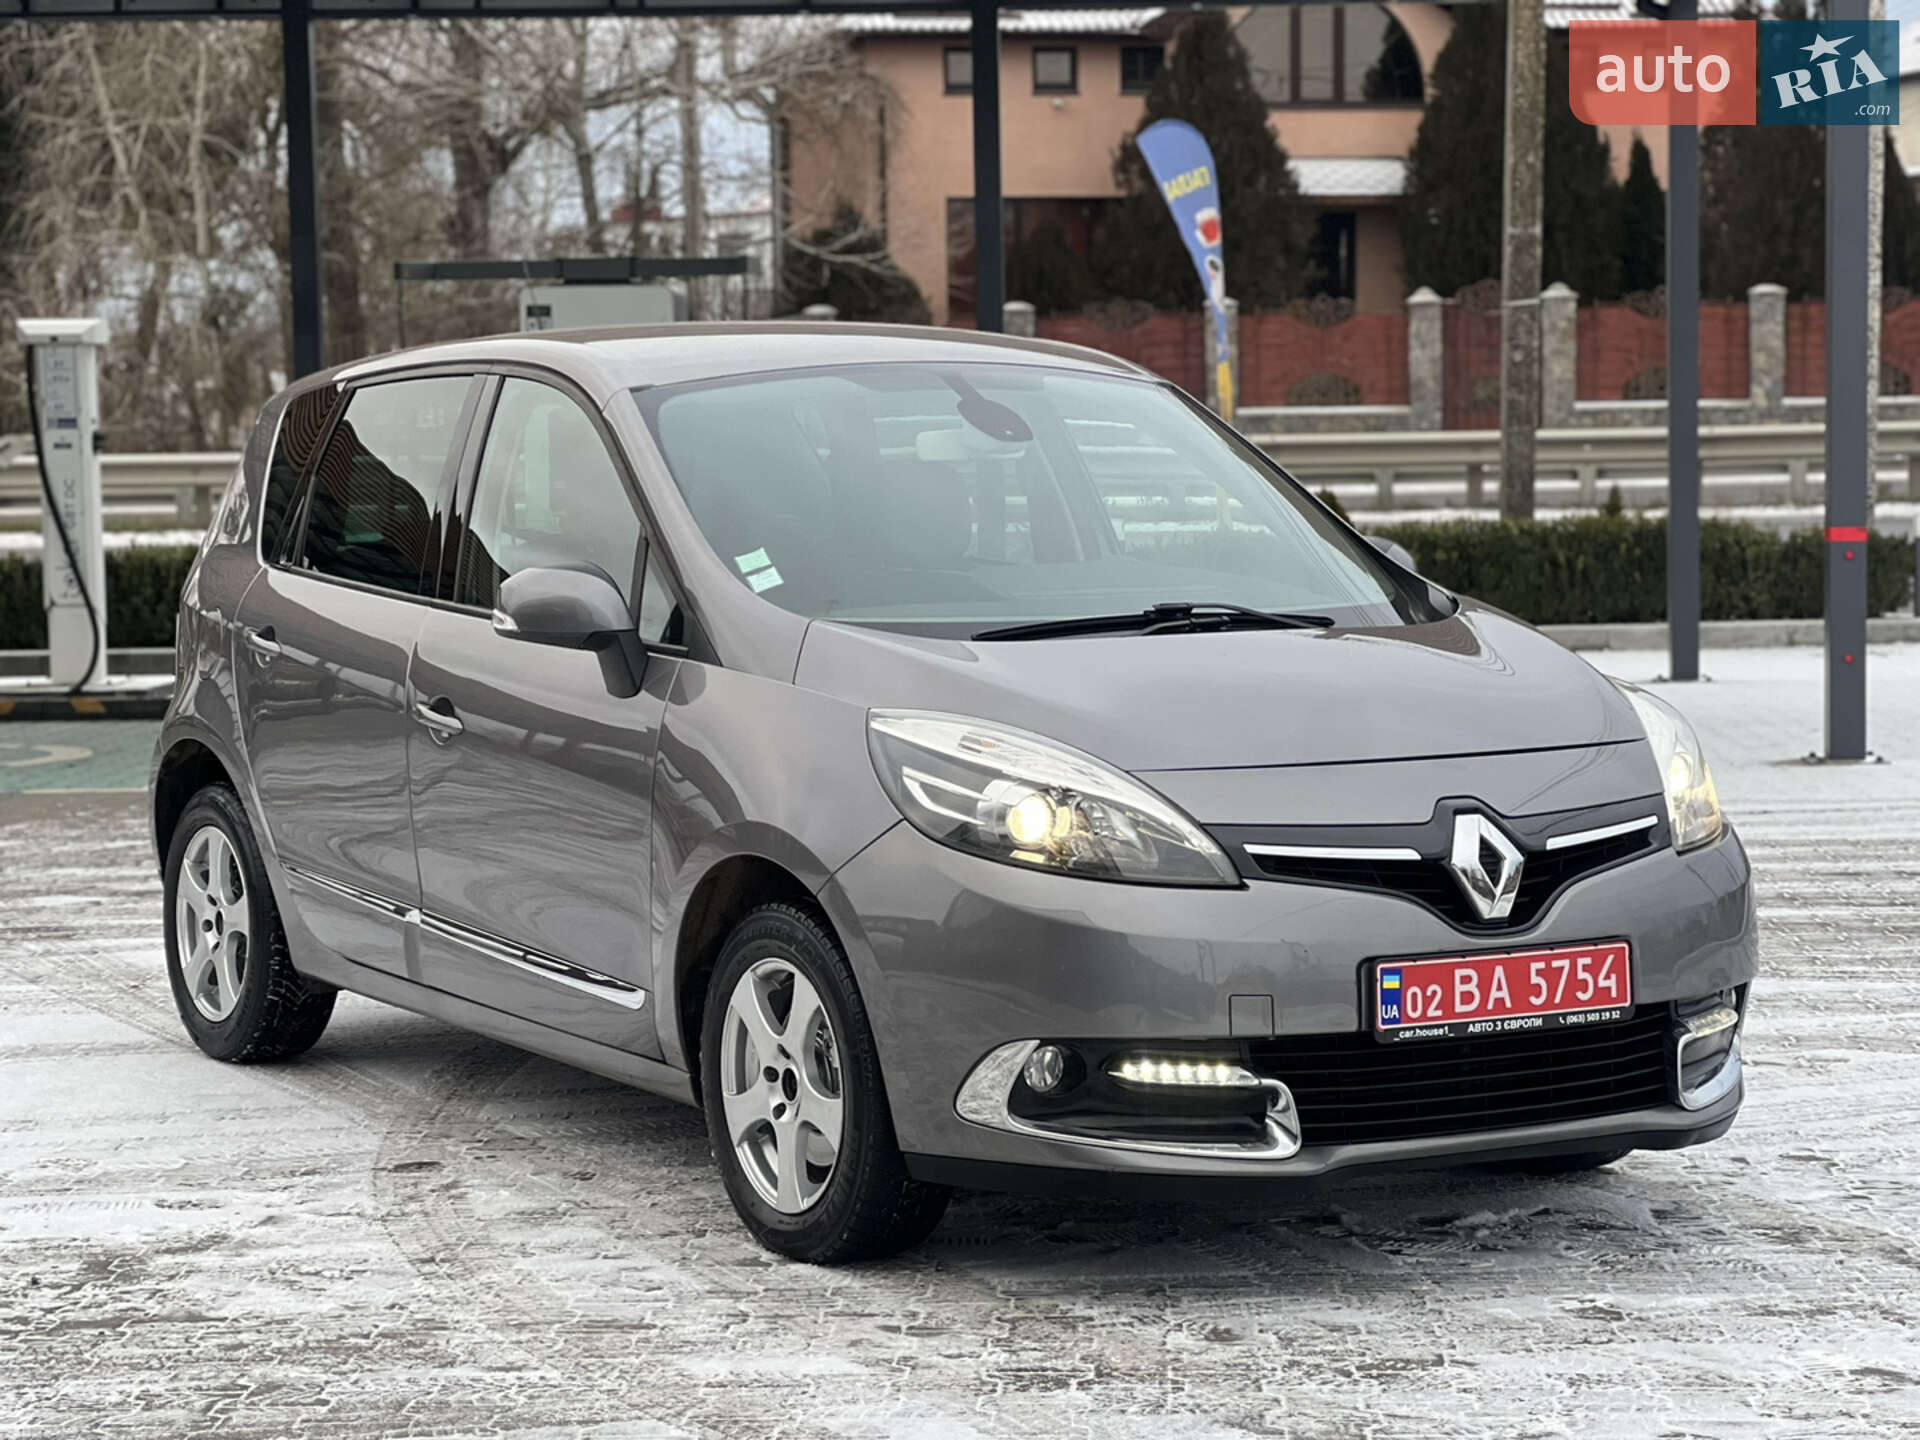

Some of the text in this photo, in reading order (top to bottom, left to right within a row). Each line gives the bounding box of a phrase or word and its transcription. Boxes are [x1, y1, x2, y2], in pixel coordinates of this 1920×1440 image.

[1405, 954, 1618, 1019] 02 BA 5754
[1382, 1004, 1400, 1019] UA
[1467, 1021, 1494, 1033] АВТО
[1503, 1017, 1543, 1030] ЄВРОПИ
